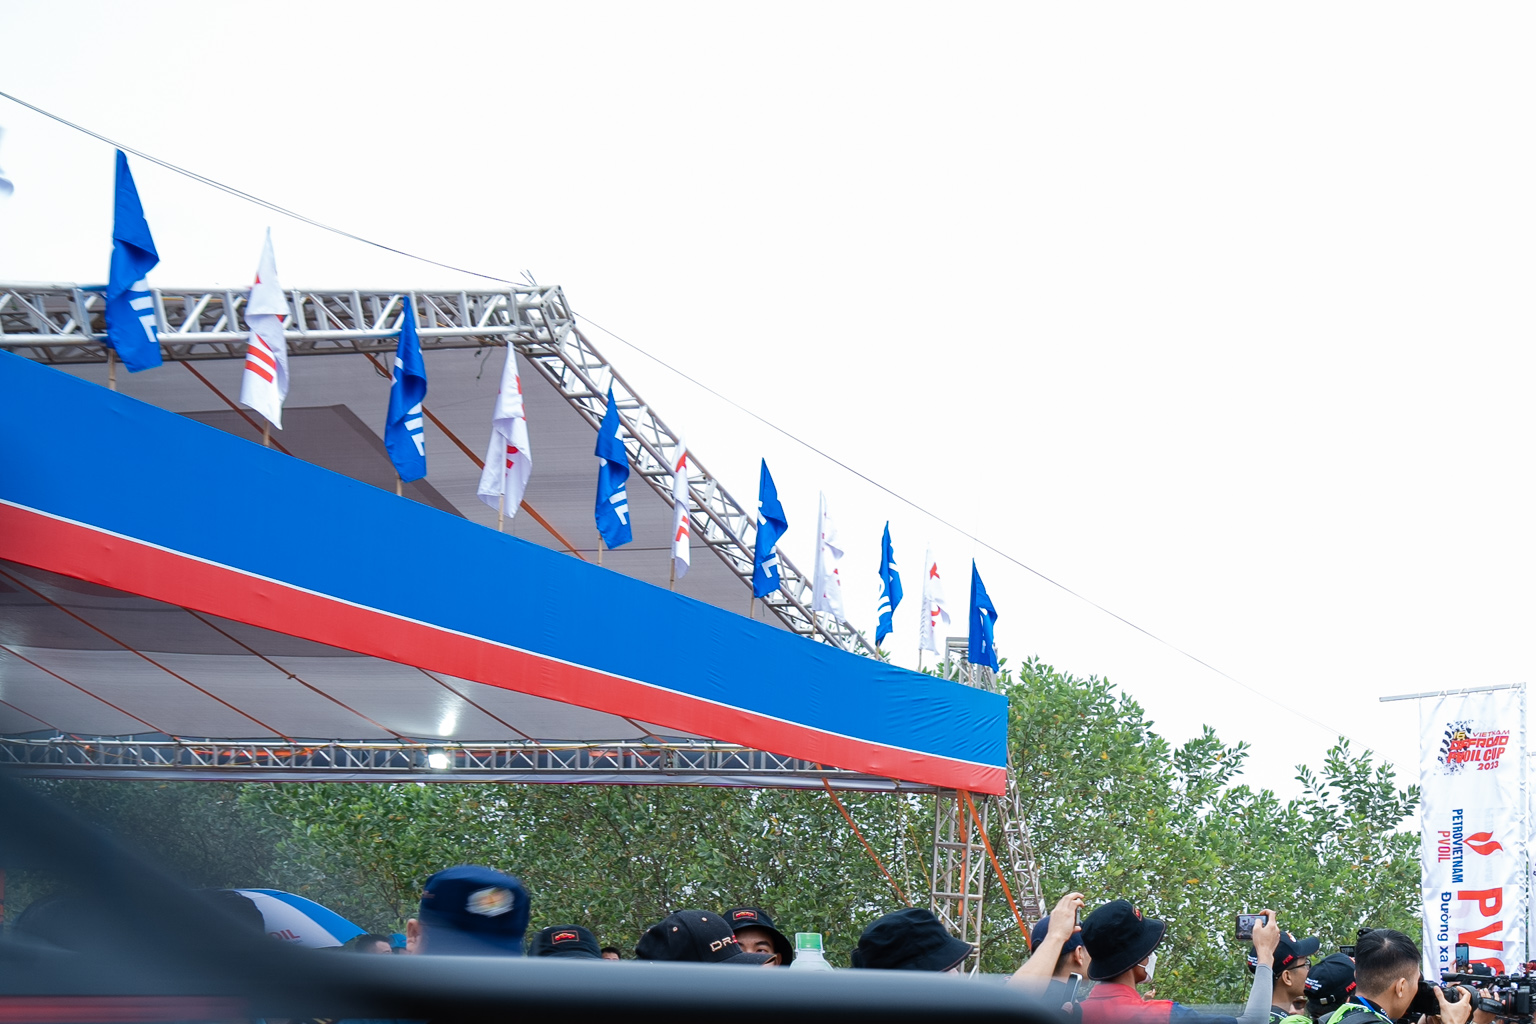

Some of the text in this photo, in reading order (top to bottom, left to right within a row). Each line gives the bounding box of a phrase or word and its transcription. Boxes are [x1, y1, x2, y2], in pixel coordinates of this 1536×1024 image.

[1450, 736, 1509, 750] OFFROAD
[1483, 747, 1505, 761] CUP
[1438, 831, 1450, 863] PVOIL
[1452, 809, 1463, 883] PETROVIETNAM
[1437, 892, 1452, 941] Đường
[1440, 945, 1448, 962] xa
